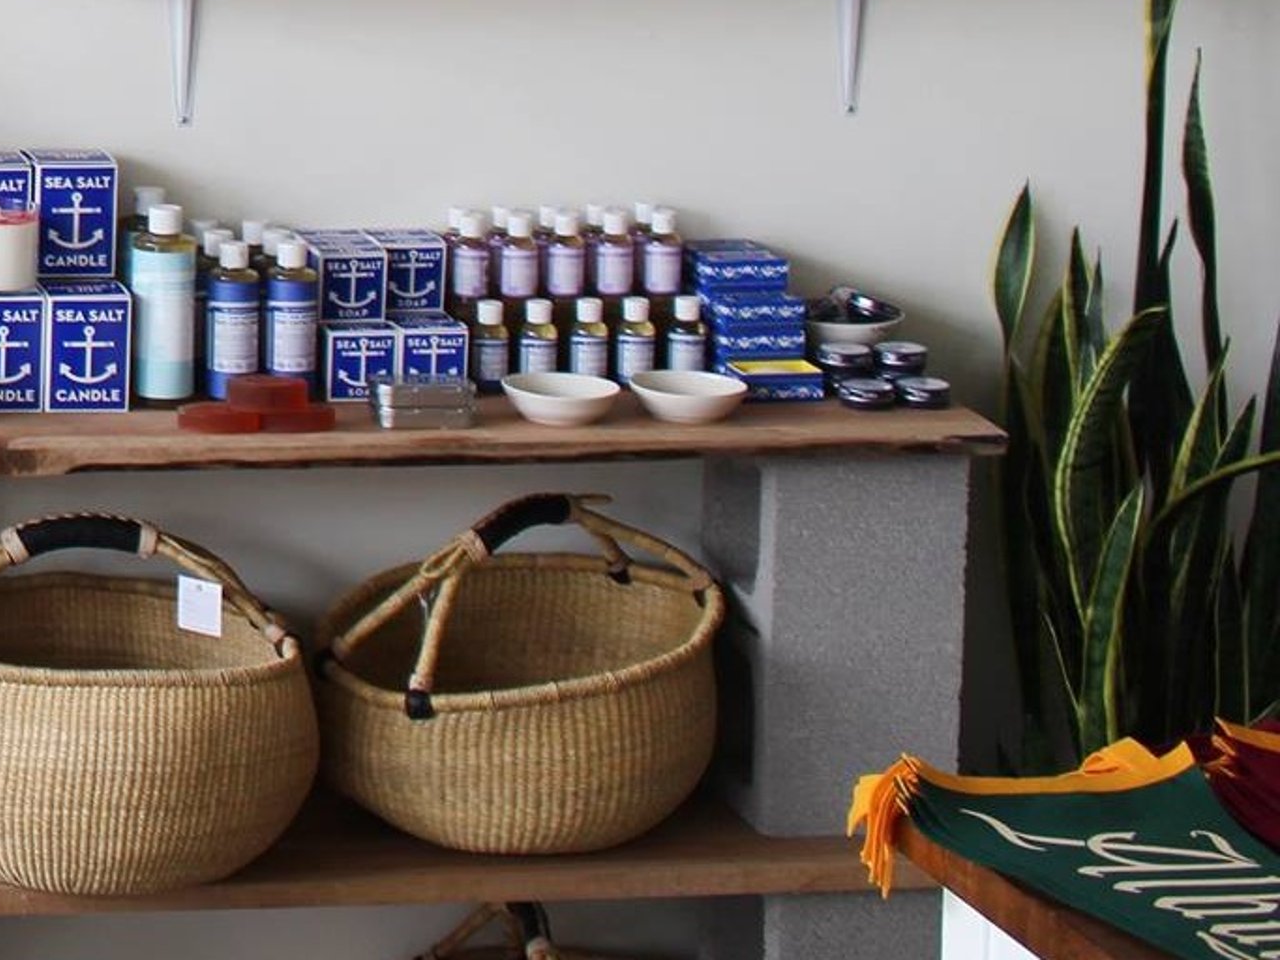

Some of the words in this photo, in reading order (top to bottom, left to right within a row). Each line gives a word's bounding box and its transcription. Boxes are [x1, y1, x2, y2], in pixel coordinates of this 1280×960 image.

[43, 176, 74, 189] SEA
[75, 176, 112, 189] SALT
[44, 254, 108, 268] CANDLE
[418, 251, 441, 260] SALT
[327, 261, 347, 271] SEA
[359, 260, 383, 270] SALT
[397, 298, 428, 307] SOAP
[3, 309, 40, 322] SALT
[56, 309, 86, 322] SEA
[89, 309, 126, 322] SALT
[337, 309, 369, 318] SOAP
[335, 339, 356, 349] SEA
[369, 339, 391, 349] SALT
[407, 338, 428, 347] SEA
[440, 337, 464, 347] SALT
[55, 389, 122, 403] CANDLE
